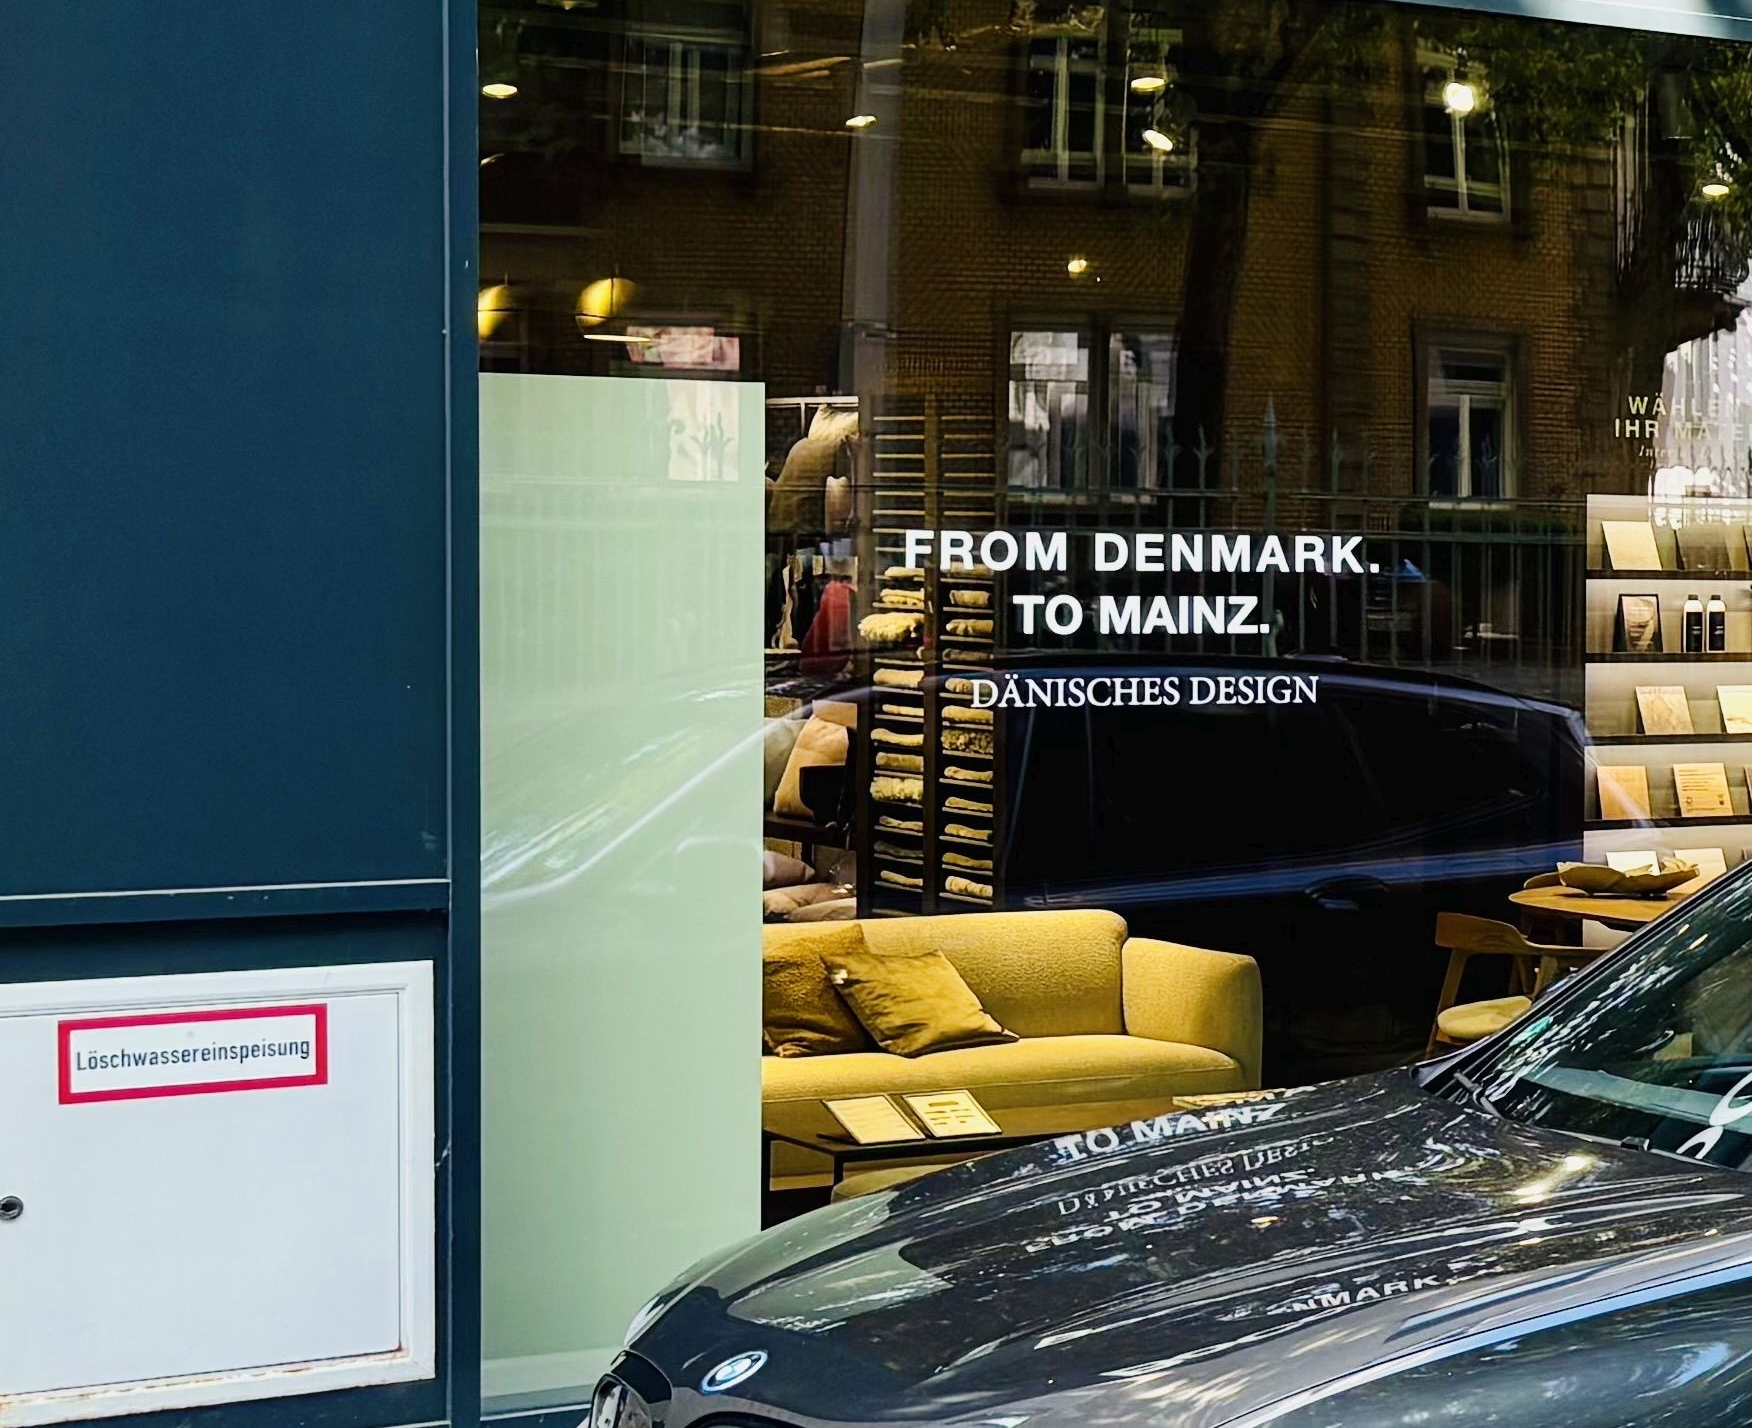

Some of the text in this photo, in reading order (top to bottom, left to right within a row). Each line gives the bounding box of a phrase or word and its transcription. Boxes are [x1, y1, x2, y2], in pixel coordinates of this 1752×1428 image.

[1614, 418, 1660, 439] IHR
[904, 529, 1381, 574] FROM DENMARK.
[1012, 594, 1271, 636] TO MAINZ.
[970, 672, 1320, 709] DÄNISCHES DESIGN
[76, 1038, 311, 1071] Löschwassereinspeisung
